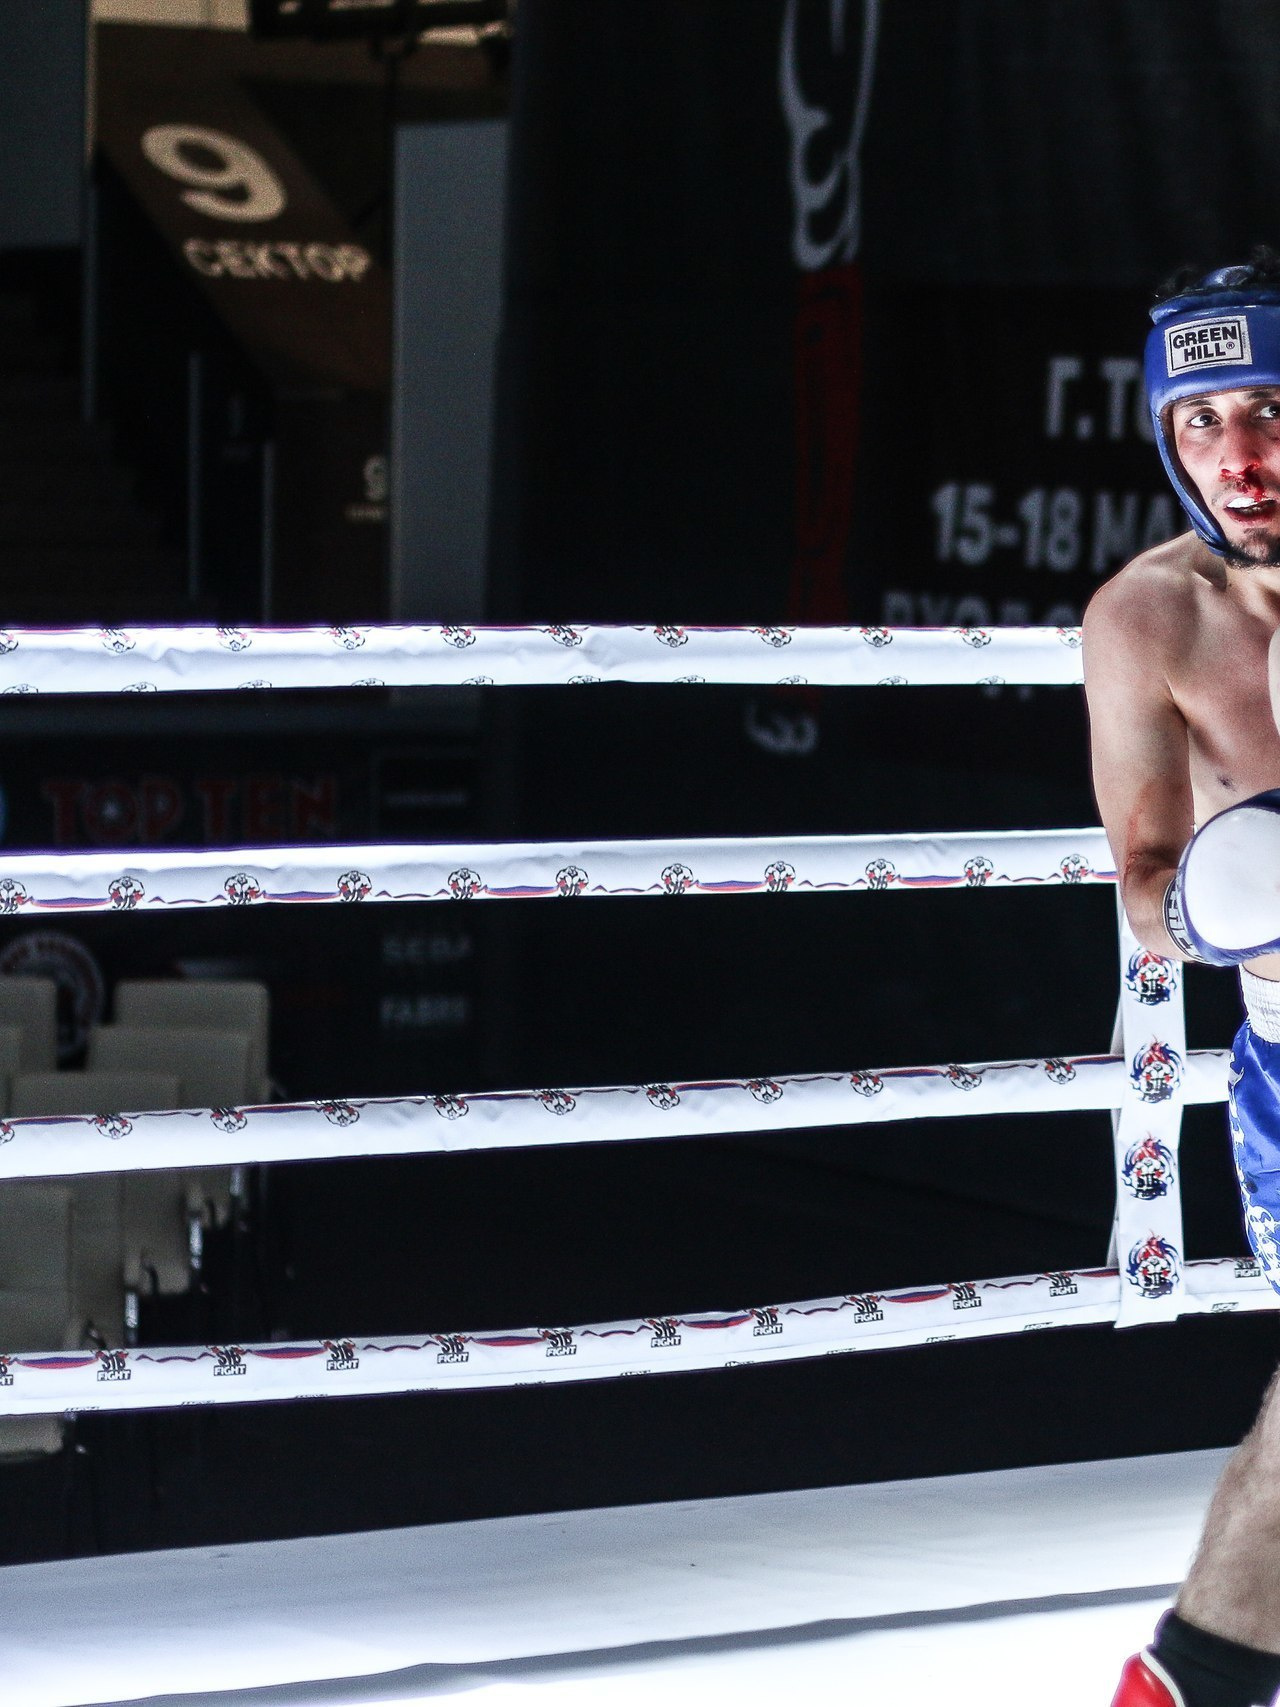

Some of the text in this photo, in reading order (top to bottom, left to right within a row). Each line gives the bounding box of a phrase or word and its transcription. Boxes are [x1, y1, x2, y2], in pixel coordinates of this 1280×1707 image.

[141, 123, 288, 223] 9
[182, 237, 373, 283] СЕКТОР
[1173, 326, 1237, 349] GREEN
[930, 481, 1083, 572] 15-18
[42, 774, 338, 845] TOP TEN
[1050, 1284, 1078, 1296] FIGHT
[953, 1297, 982, 1310] FIGHT
[854, 1310, 884, 1324] FIGHT
[753, 1323, 783, 1336] FIGHT
[651, 1335, 681, 1347] FIGHT
[437, 1352, 469, 1364] FIGHT
[546, 1345, 577, 1358] FIGHT
[214, 1363, 247, 1377] FIGHT
[327, 1358, 359, 1371] FIGHT
[97, 1369, 131, 1382] FIGHT
